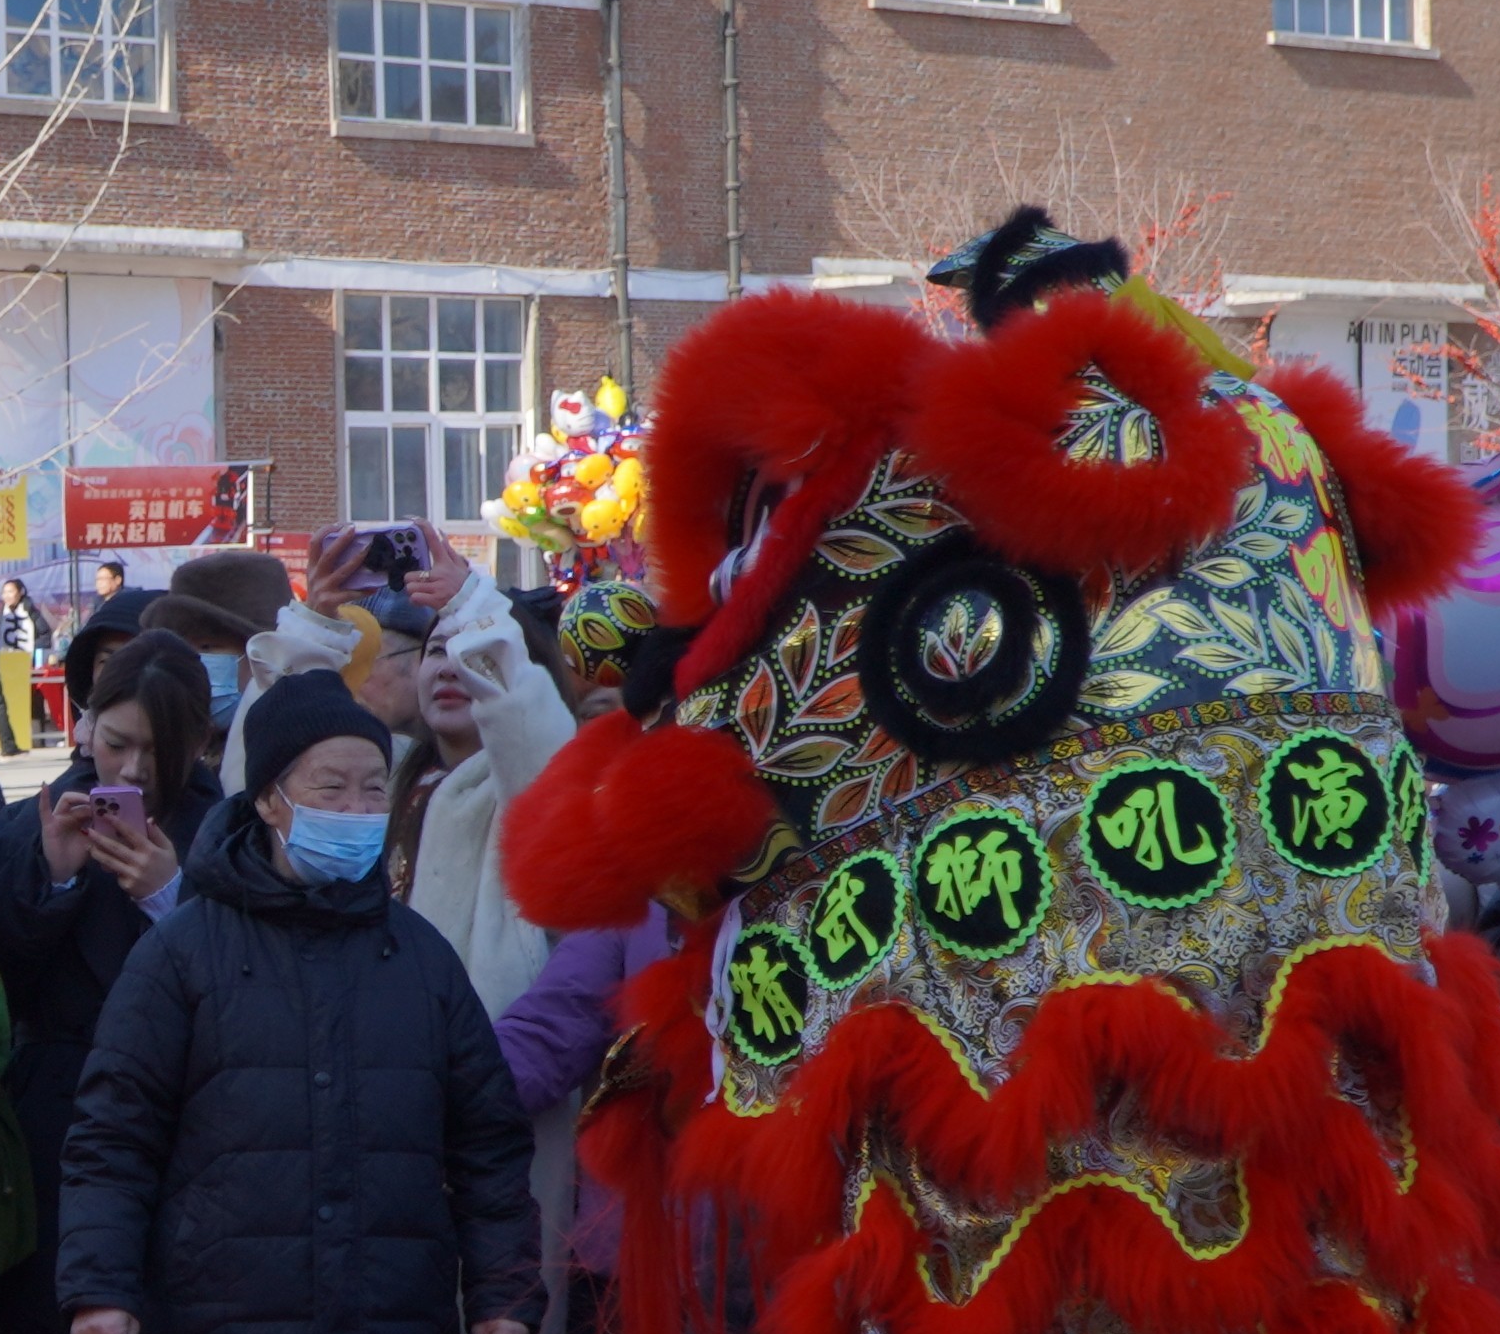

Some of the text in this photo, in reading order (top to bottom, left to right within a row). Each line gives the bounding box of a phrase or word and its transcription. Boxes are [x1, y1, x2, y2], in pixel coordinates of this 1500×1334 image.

[1400, 322, 1442, 346] PLAY
[128, 499, 204, 521] 英雄机车
[85, 522, 166, 545] 再次起航
